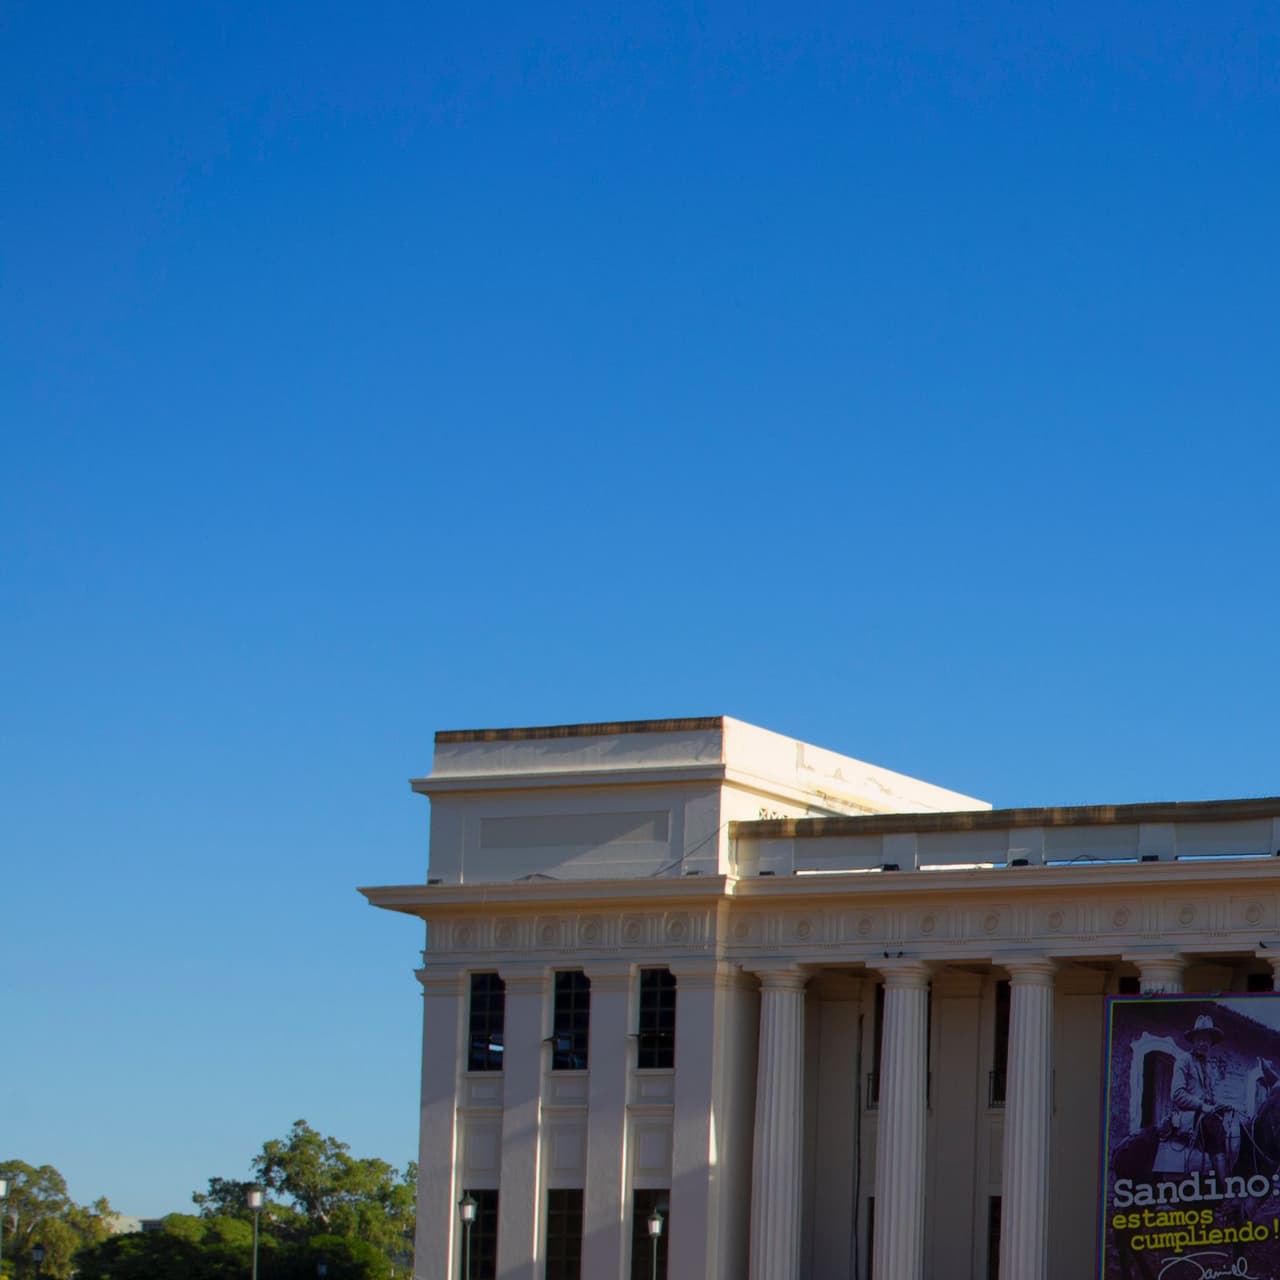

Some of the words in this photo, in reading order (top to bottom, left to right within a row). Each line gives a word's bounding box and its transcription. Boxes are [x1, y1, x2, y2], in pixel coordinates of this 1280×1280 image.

[1113, 1170, 1280, 1208] Sandino:
[1111, 1208, 1215, 1231] estamos
[1130, 1217, 1280, 1254] cumpliendo!
